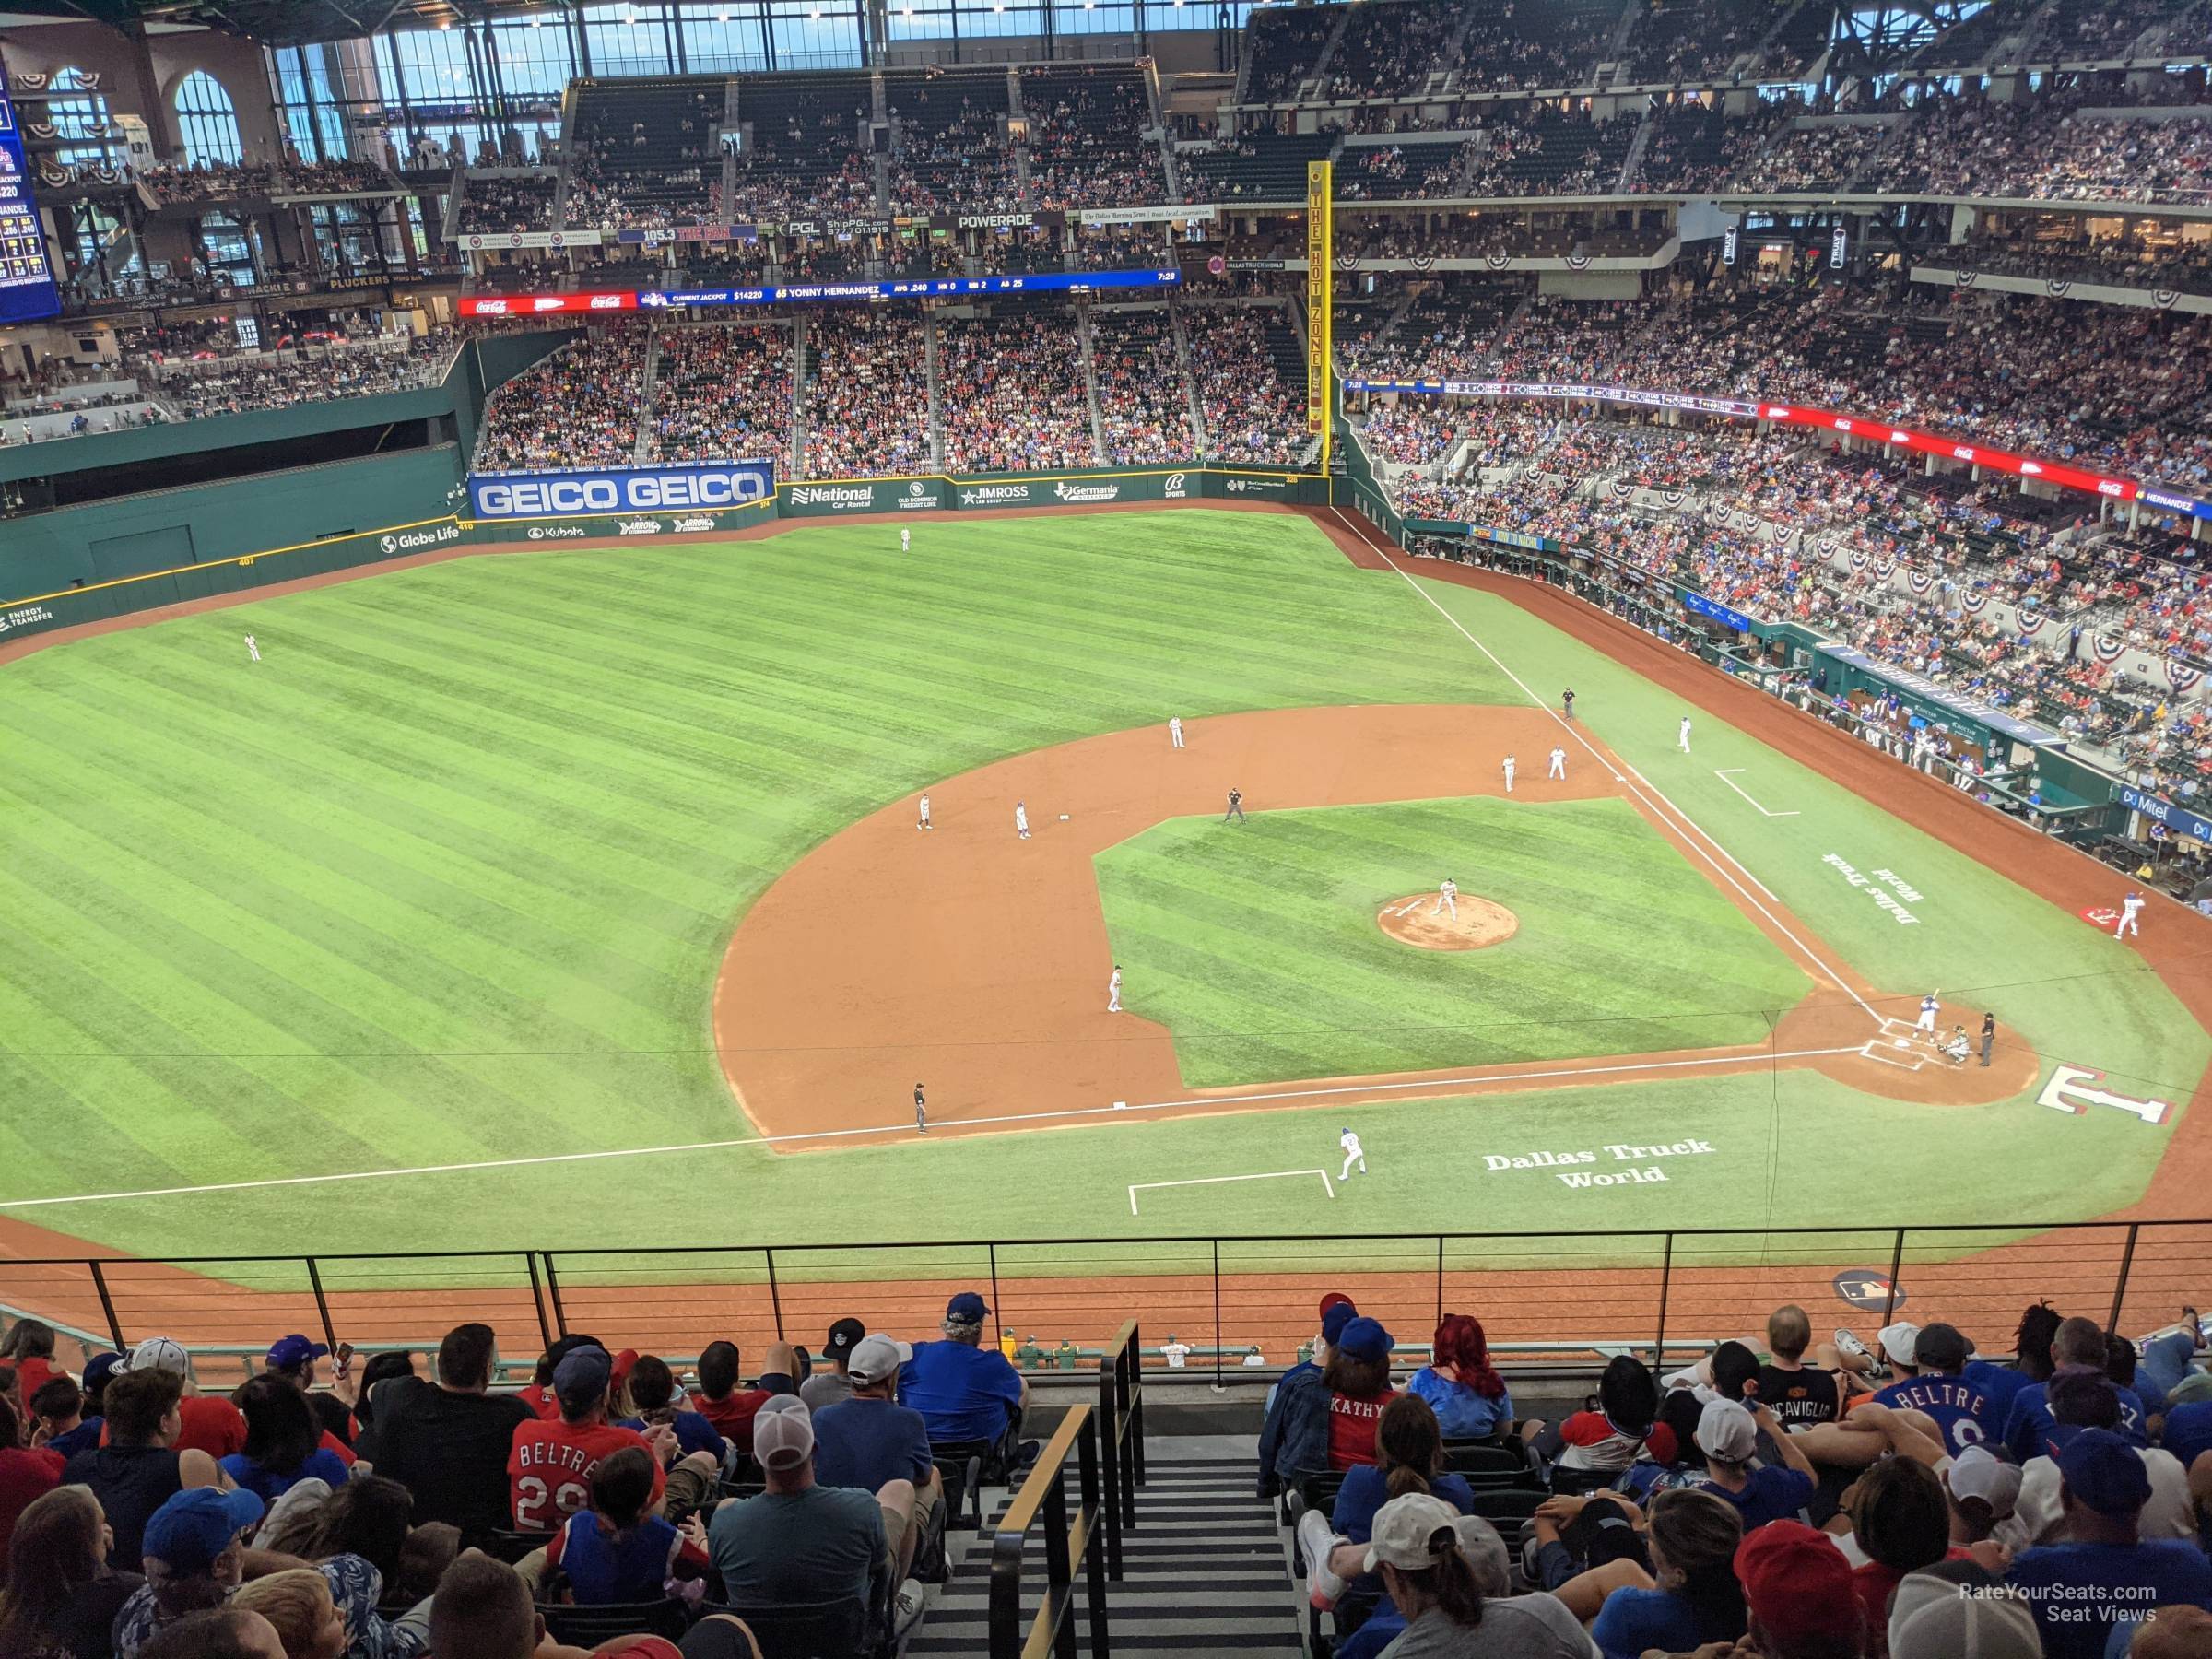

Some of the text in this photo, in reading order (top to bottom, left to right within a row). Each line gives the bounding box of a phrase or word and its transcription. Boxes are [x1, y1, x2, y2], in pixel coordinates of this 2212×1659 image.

[789, 222, 820, 235] PGL
[959, 214, 1033, 229] POWERADE
[643, 229, 676, 241] 105.3
[1832, 236, 1841, 261] TRULY
[330, 276, 391, 288] PLUCKERS
[910, 283, 927, 292] .240
[950, 282, 956, 290] 0
[981, 281, 987, 289] 2
[1013, 279, 1023, 288] 25
[1158, 272, 1175, 281] 7:28
[1310, 194, 1321, 366] THE HOT ZONE
[672, 290, 763, 302] CURRENT JACKPOT $14220
[775, 286, 879, 299] 65 YONNY HERNANDEZ
[238, 325, 257, 334] SLAM
[240, 332, 258, 340] TEAM
[478, 472, 766, 514] GEICO GEICO
[1073, 483, 1118, 495] Germania
[2147, 493, 2194, 512] HERNANDEZ
[545, 526, 583, 538] Kubota
[629, 521, 655, 531] ARROW
[683, 519, 709, 528] ARROW
[399, 525, 459, 547] Globe Life
[239, 556, 254, 566] 407
[9, 606, 41, 619] ENERGY
[11, 612, 53, 626] TRANSFER
[1866, 663, 1939, 693] RANGERS
[1934, 692, 1994, 717] TEXAS
[2138, 795, 2169, 820] Mitel
[1821, 853, 1921, 924] Dallas Truck
[1871, 869, 1924, 902] World
[1482, 1138, 1716, 1171] Dallas Truck
[1556, 1166, 1670, 1189] World
[1330, 1397, 1385, 1418] KATHY
[1895, 1384, 1983, 1415] BELTRE
[520, 1441, 599, 1479] BELTRE
